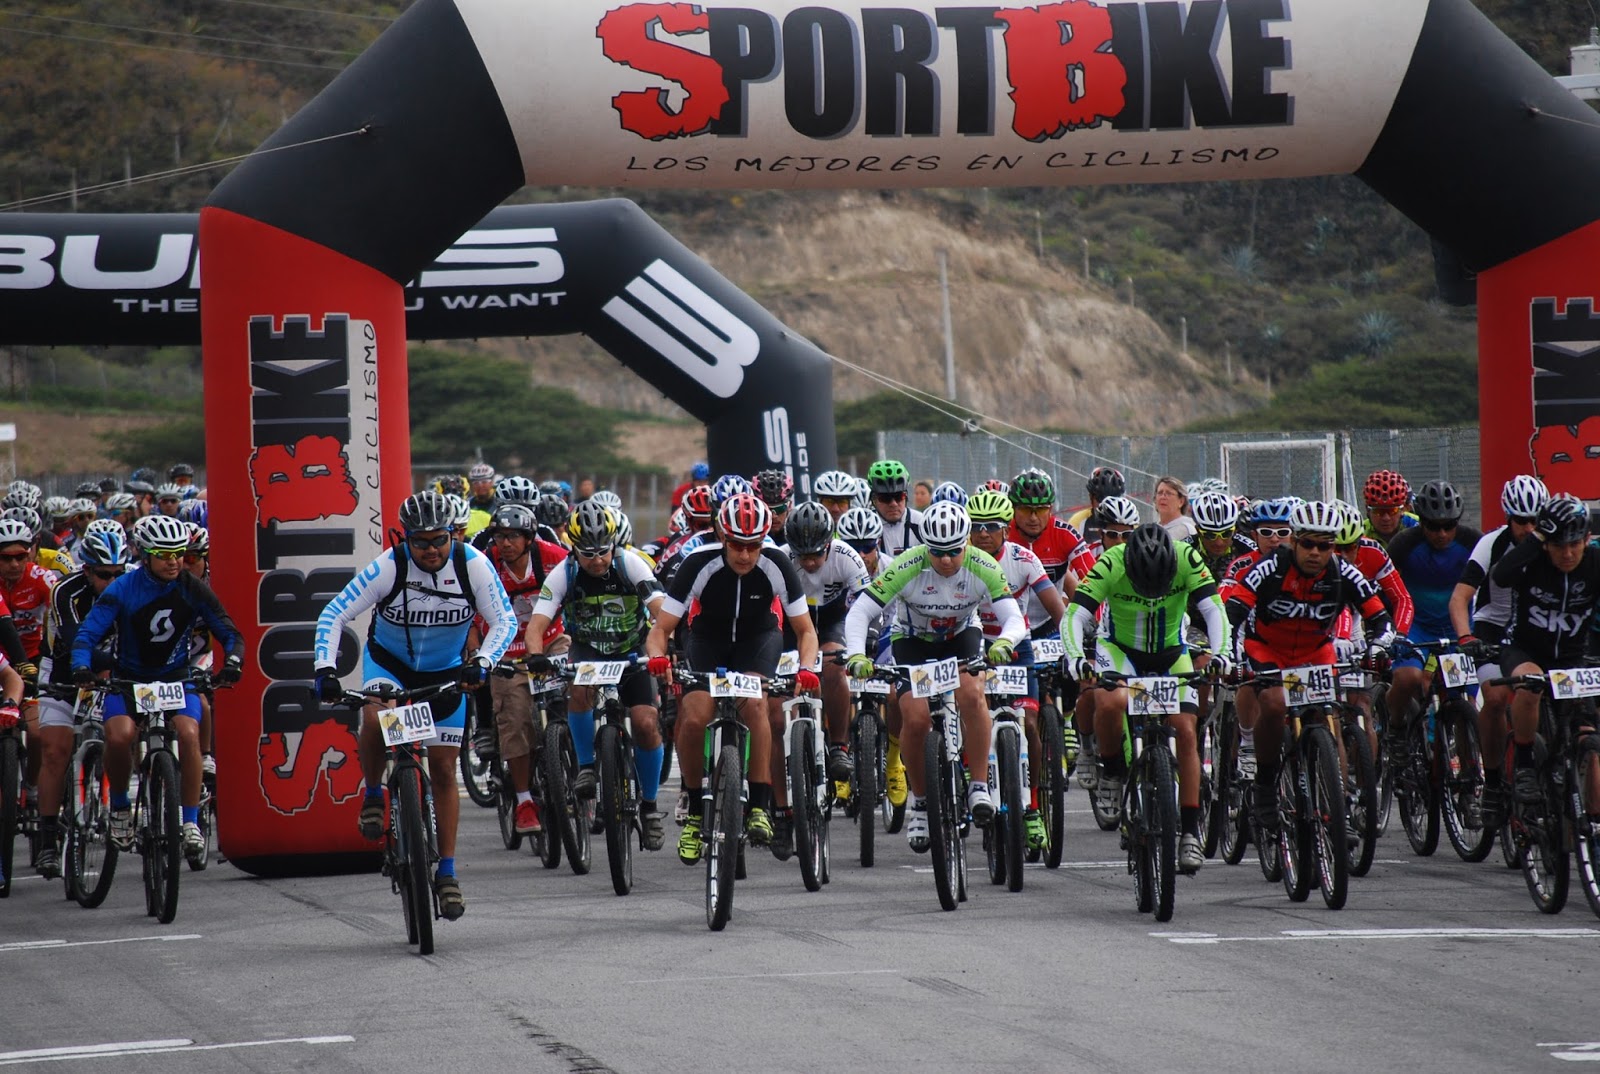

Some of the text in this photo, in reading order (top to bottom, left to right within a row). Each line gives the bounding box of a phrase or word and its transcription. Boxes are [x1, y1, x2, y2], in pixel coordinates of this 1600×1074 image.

[596, 0, 1294, 141] SPORTBIKE
[626, 146, 1282, 173] LOS MEJORES EN CICLISMO
[114, 299, 198, 313] THE
[441, 292, 568, 310] WANT
[363, 323, 382, 546] EN CICLISMO
[248, 312, 362, 815] SPORTBIKE
[897, 553, 924, 572] KENDA
[970, 554, 997, 571] KENDA
[384, 605, 471, 625] SHIMANO
[1528, 605, 1592, 638] SKY
[599, 663, 622, 677] 410
[933, 660, 958, 684] 432
[1001, 668, 1026, 686] 442
[1307, 668, 1331, 692] 415
[158, 684, 183, 700] 448
[733, 675, 760, 691] 425
[1153, 681, 1178, 703] 452
[404, 704, 432, 730] 409
